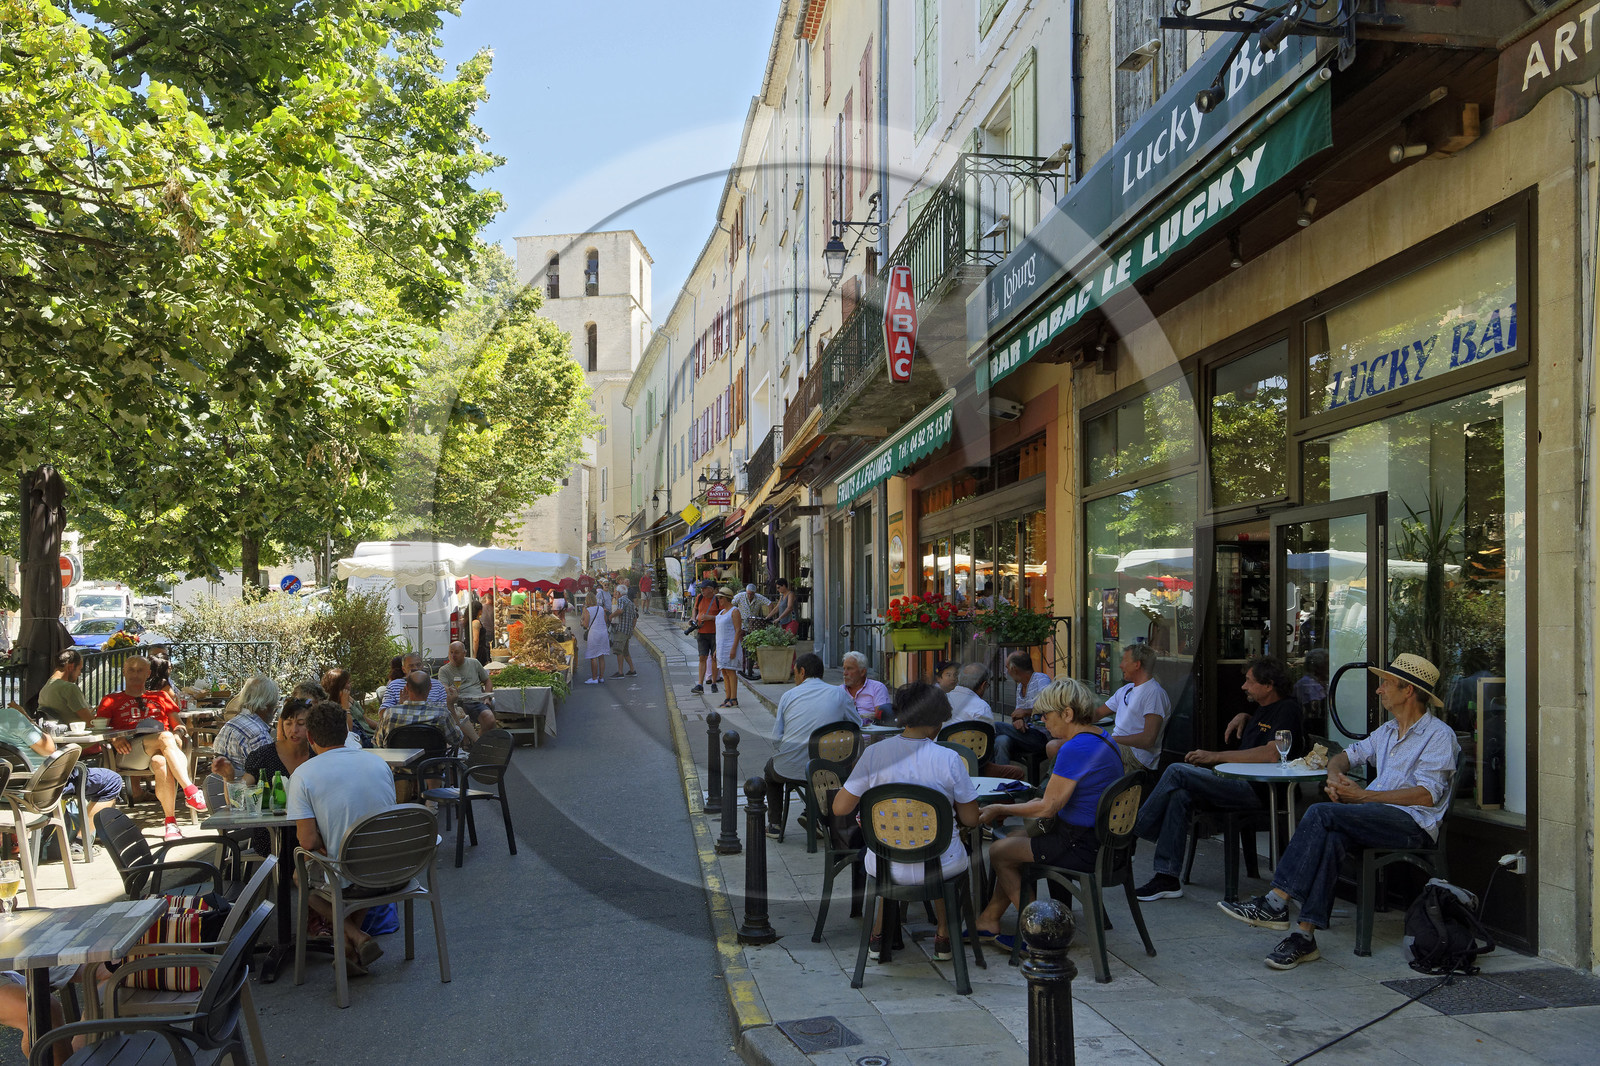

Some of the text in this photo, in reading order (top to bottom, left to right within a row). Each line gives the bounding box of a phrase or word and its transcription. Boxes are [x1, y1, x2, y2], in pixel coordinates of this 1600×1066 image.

[1121, 102, 1204, 196] Lucky
[989, 141, 1267, 382] BAR TABAC LE LUCKY
[1003, 252, 1037, 310] Loburg
[892, 269, 914, 378] TABAC
[1328, 334, 1439, 410] LUCKY
[838, 475, 856, 504] FRUITS
[910, 432, 918, 453] 04
[918, 427, 926, 448] 92
[927, 421, 935, 443] 75
[935, 415, 943, 437] 13
[689, 512, 701, 525] PRESSE
